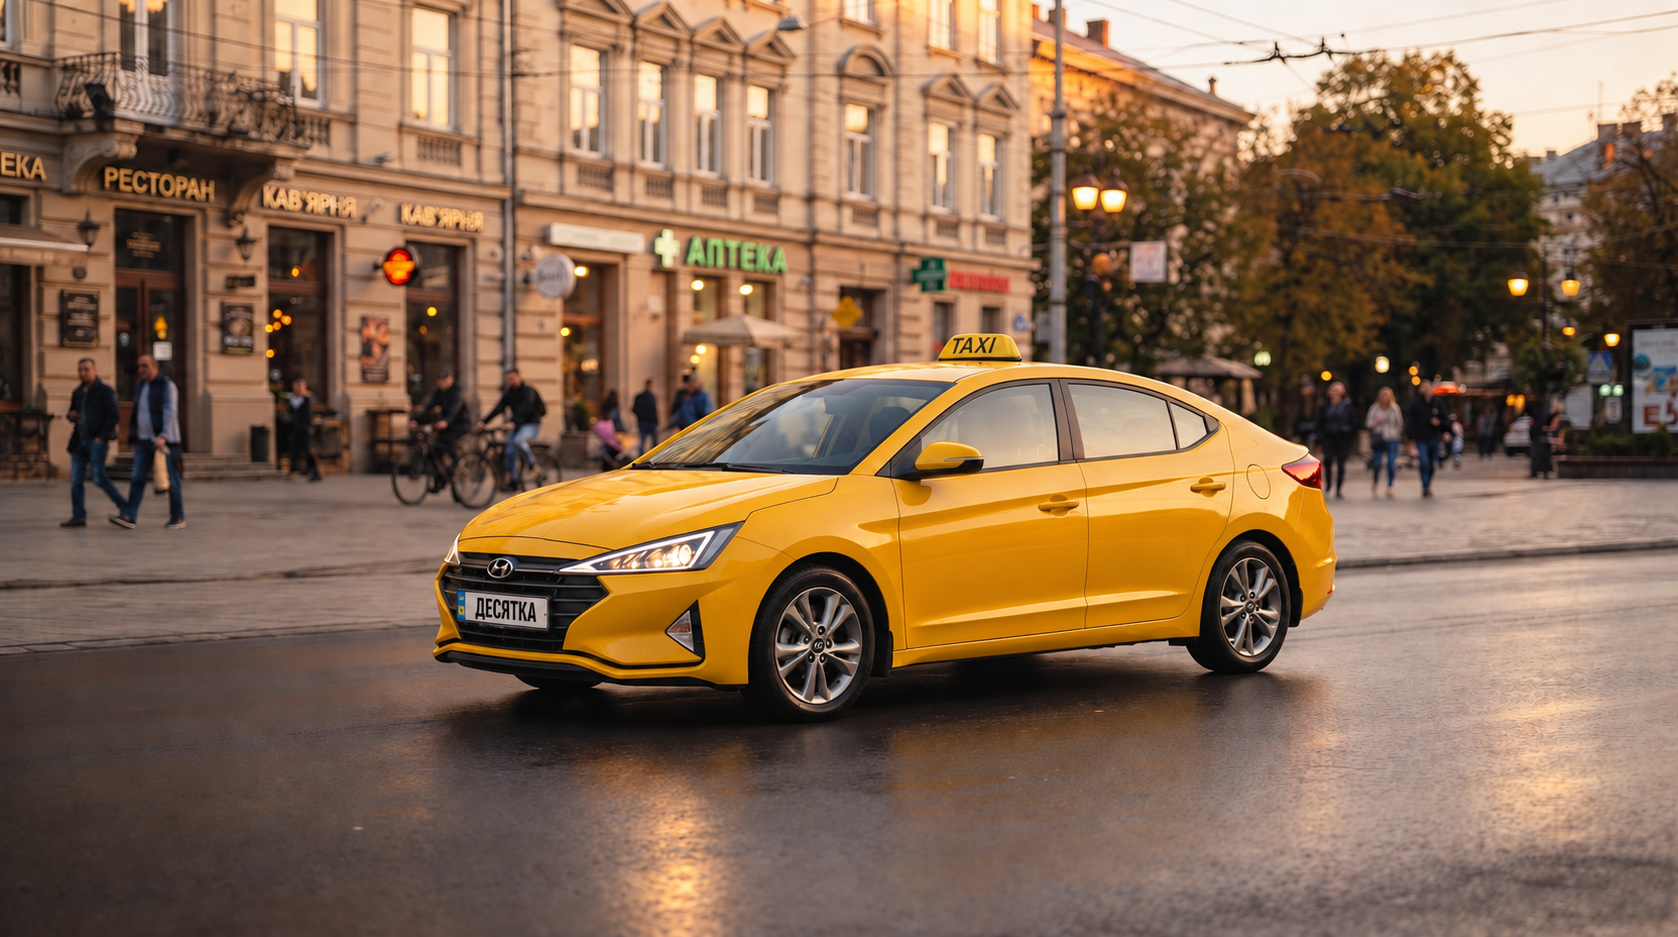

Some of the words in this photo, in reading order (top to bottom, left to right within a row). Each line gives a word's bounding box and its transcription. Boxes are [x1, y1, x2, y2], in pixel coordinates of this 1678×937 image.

[1, 152, 47, 182] ЕКА
[104, 166, 216, 202] РЕСТОРАН
[686, 236, 788, 273] АПТЕКА
[952, 337, 997, 354] TAXI
[475, 597, 537, 622] ДЕСЯТКА
